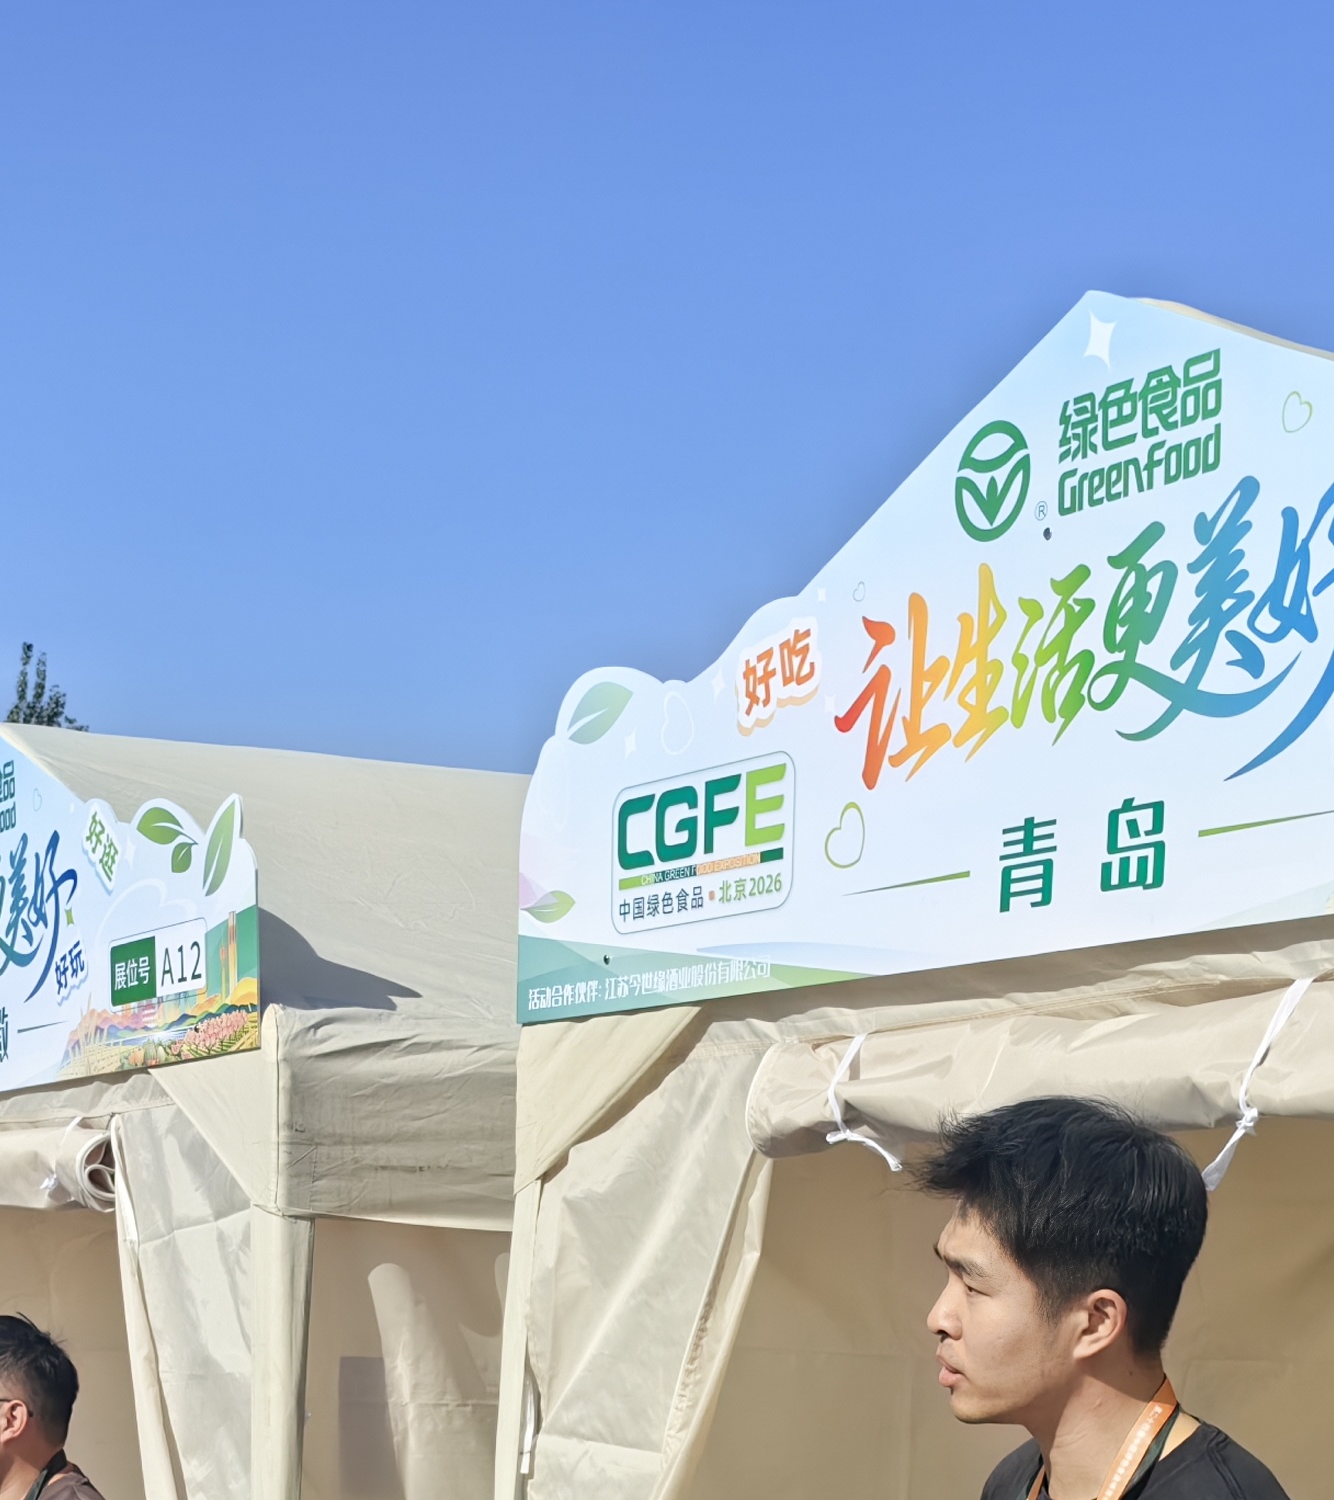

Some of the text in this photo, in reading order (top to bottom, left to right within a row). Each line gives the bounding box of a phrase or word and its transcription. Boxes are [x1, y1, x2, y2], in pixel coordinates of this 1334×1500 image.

[1058, 347, 1222, 464] 绿色食品
[740, 628, 816, 716] 好吃
[86, 810, 120, 882] 好逛
[618, 763, 787, 870] CGFE
[998, 797, 1167, 913] 青岛
[55, 939, 85, 995] 好玩
[114, 940, 202, 990] 展位号 A12
